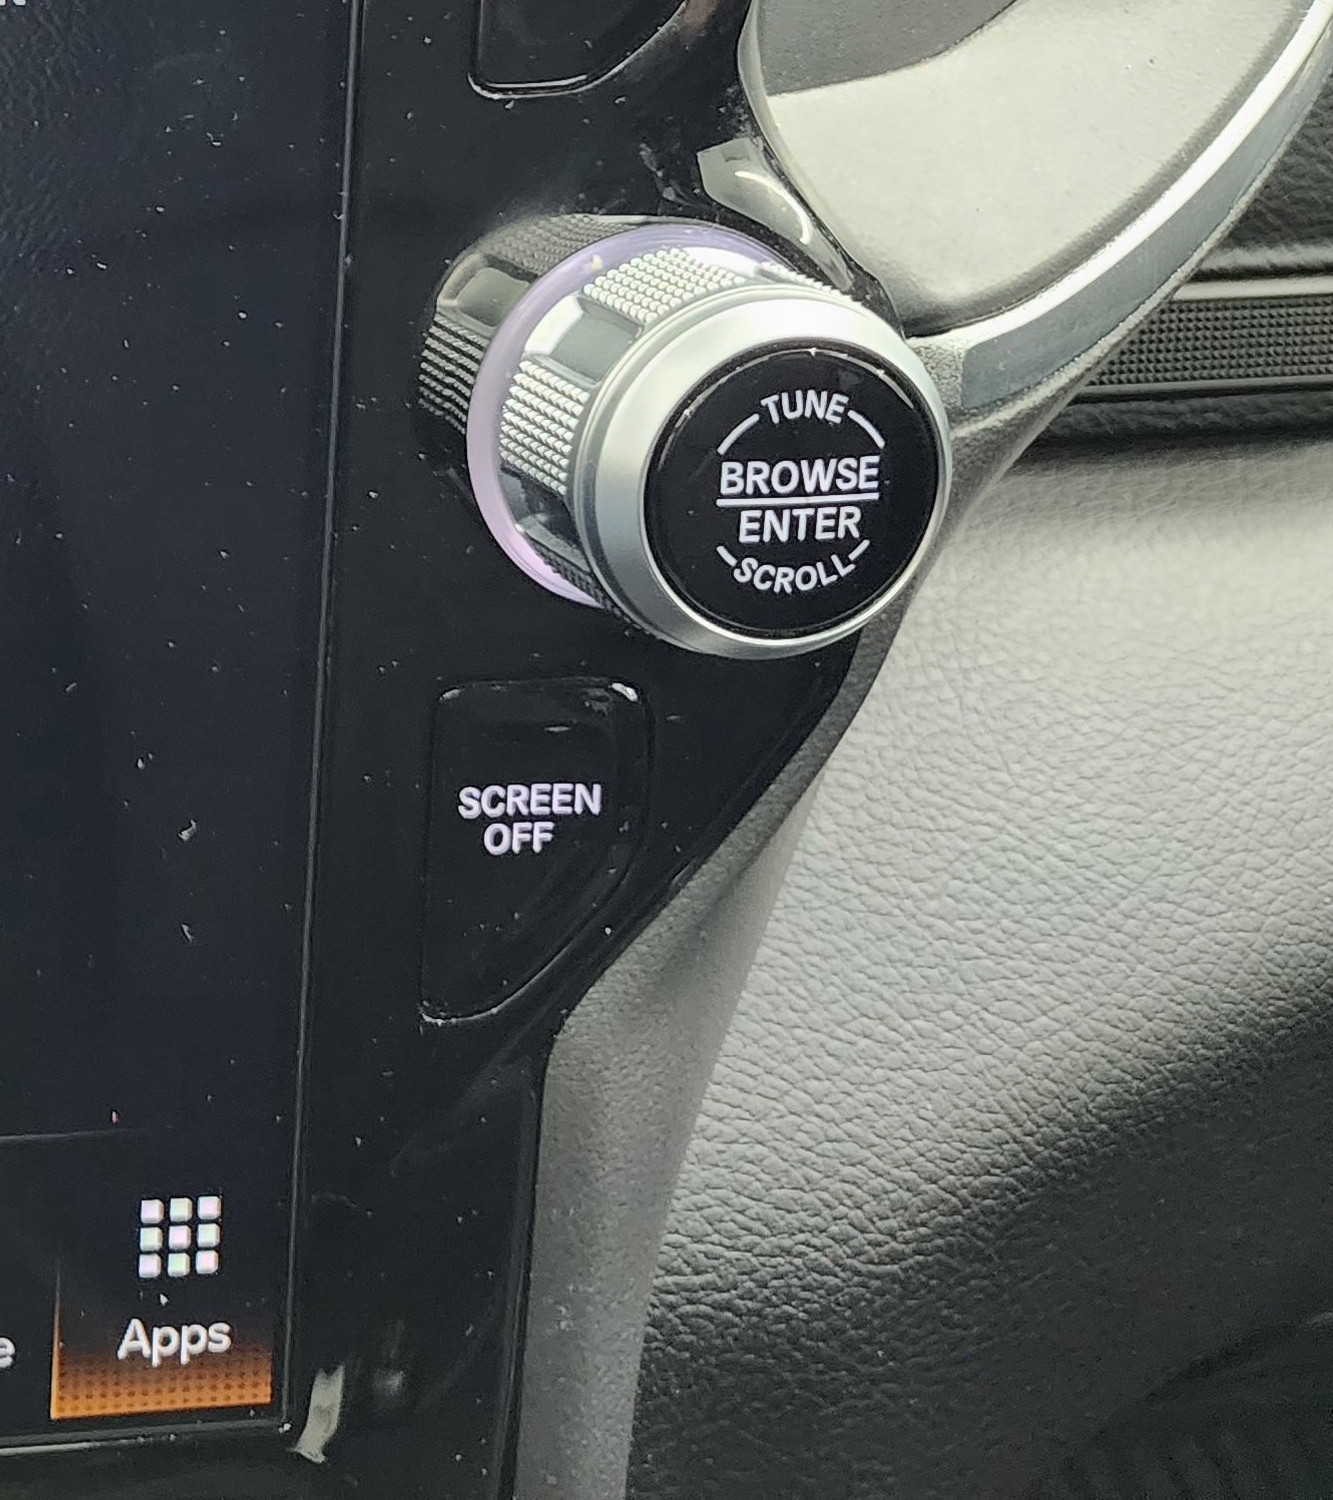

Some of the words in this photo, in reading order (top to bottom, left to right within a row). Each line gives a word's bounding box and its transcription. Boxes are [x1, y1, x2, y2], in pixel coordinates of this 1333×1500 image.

[760, 389, 849, 426] TUNE
[719, 455, 880, 496] BROWSE
[738, 506, 861, 543] ENTER
[733, 554, 856, 594] SCROLL
[458, 783, 602, 820] SCREEN
[483, 821, 555, 855] OFF
[117, 1317, 233, 1368] Apps
